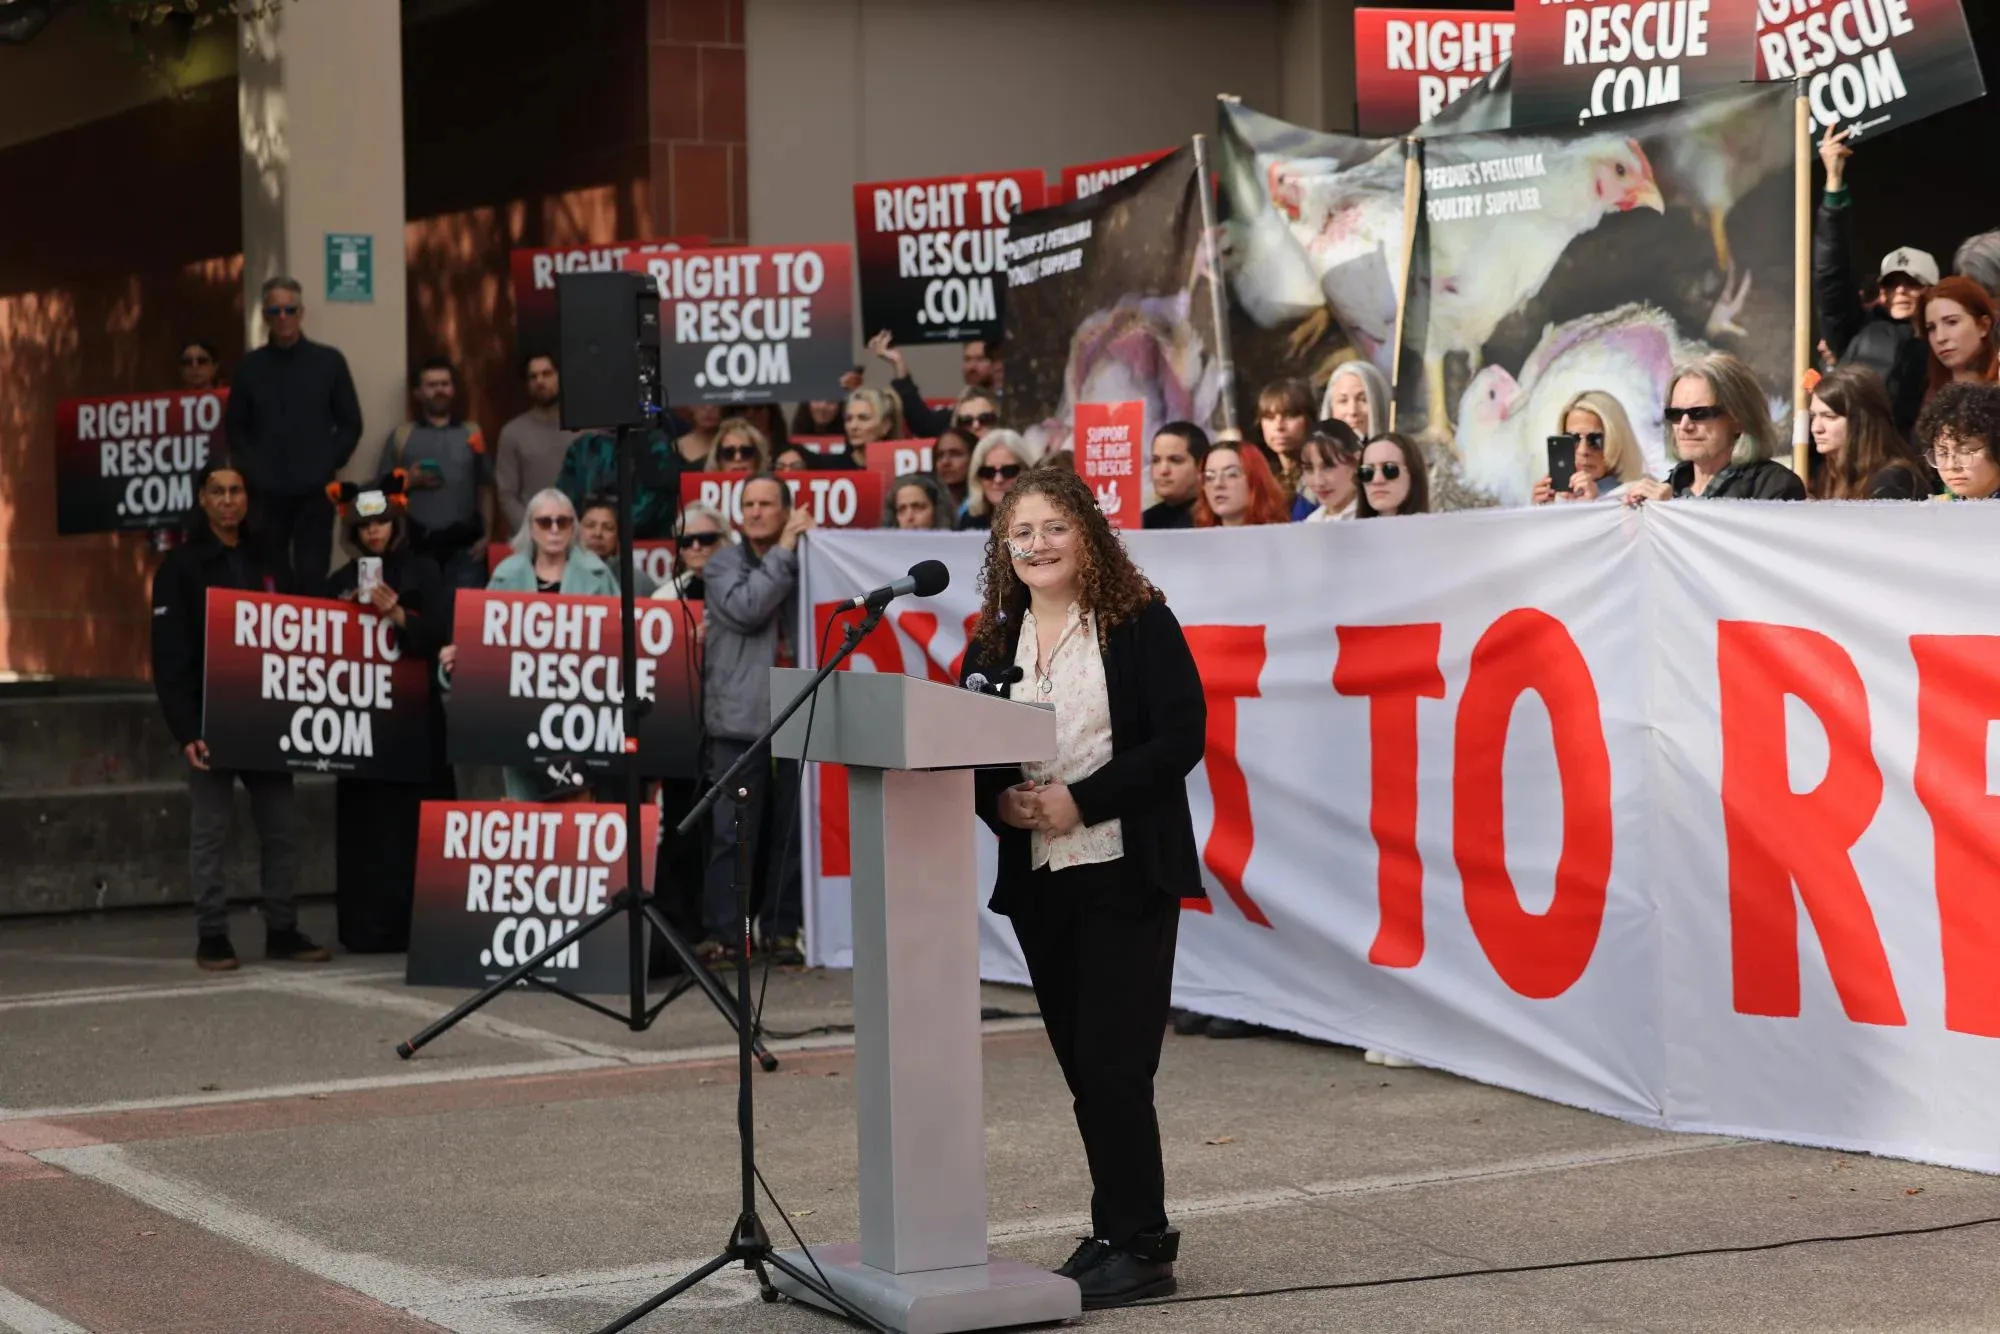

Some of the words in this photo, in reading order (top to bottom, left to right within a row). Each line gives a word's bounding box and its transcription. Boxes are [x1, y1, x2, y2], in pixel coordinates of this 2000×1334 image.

[1386, 19, 1515, 72] RIGHT
[1564, 0, 1709, 65] RESCUE
[1760, 0, 1914, 80] RESCUE
[1480, 153, 1547, 184] PETALUMA
[873, 181, 968, 232] RIGHT
[977, 177, 1022, 225] TO
[1484, 186, 1543, 216] SUPPLIER
[647, 253, 761, 300] RIGHT
[771, 250, 825, 295] TO
[897, 227, 1010, 278] RESCUE
[675, 294, 813, 344] RESCUE
[916, 276, 997, 326] .COM
[694, 341, 791, 388] .COM
[77, 398, 171, 441] RIGHT
[180, 393, 222, 433] TO
[1086, 424, 1129, 443] SUPPORT
[101, 433, 211, 478] RESCUE
[1084, 460, 1097, 477] TO
[1097, 459, 1133, 476] RESCUE
[1085, 444, 1103, 460] THE
[116, 473, 194, 516] .COM
[809, 478, 858, 526] TO
[234, 599, 348, 656] RIGHT
[357, 613, 401, 662] TO
[482, 599, 608, 650] RIGHT
[619, 606, 674, 656] O
[261, 652, 394, 710] RESCUE
[278, 705, 374, 757] .COM
[526, 702, 627, 754] .COM
[1334, 606, 1613, 1000] TO
[443, 810, 563, 862] RIGHT
[574, 812, 628, 864] TO
[466, 863, 610, 916] RESCUE
[479, 916, 581, 969] .COM
